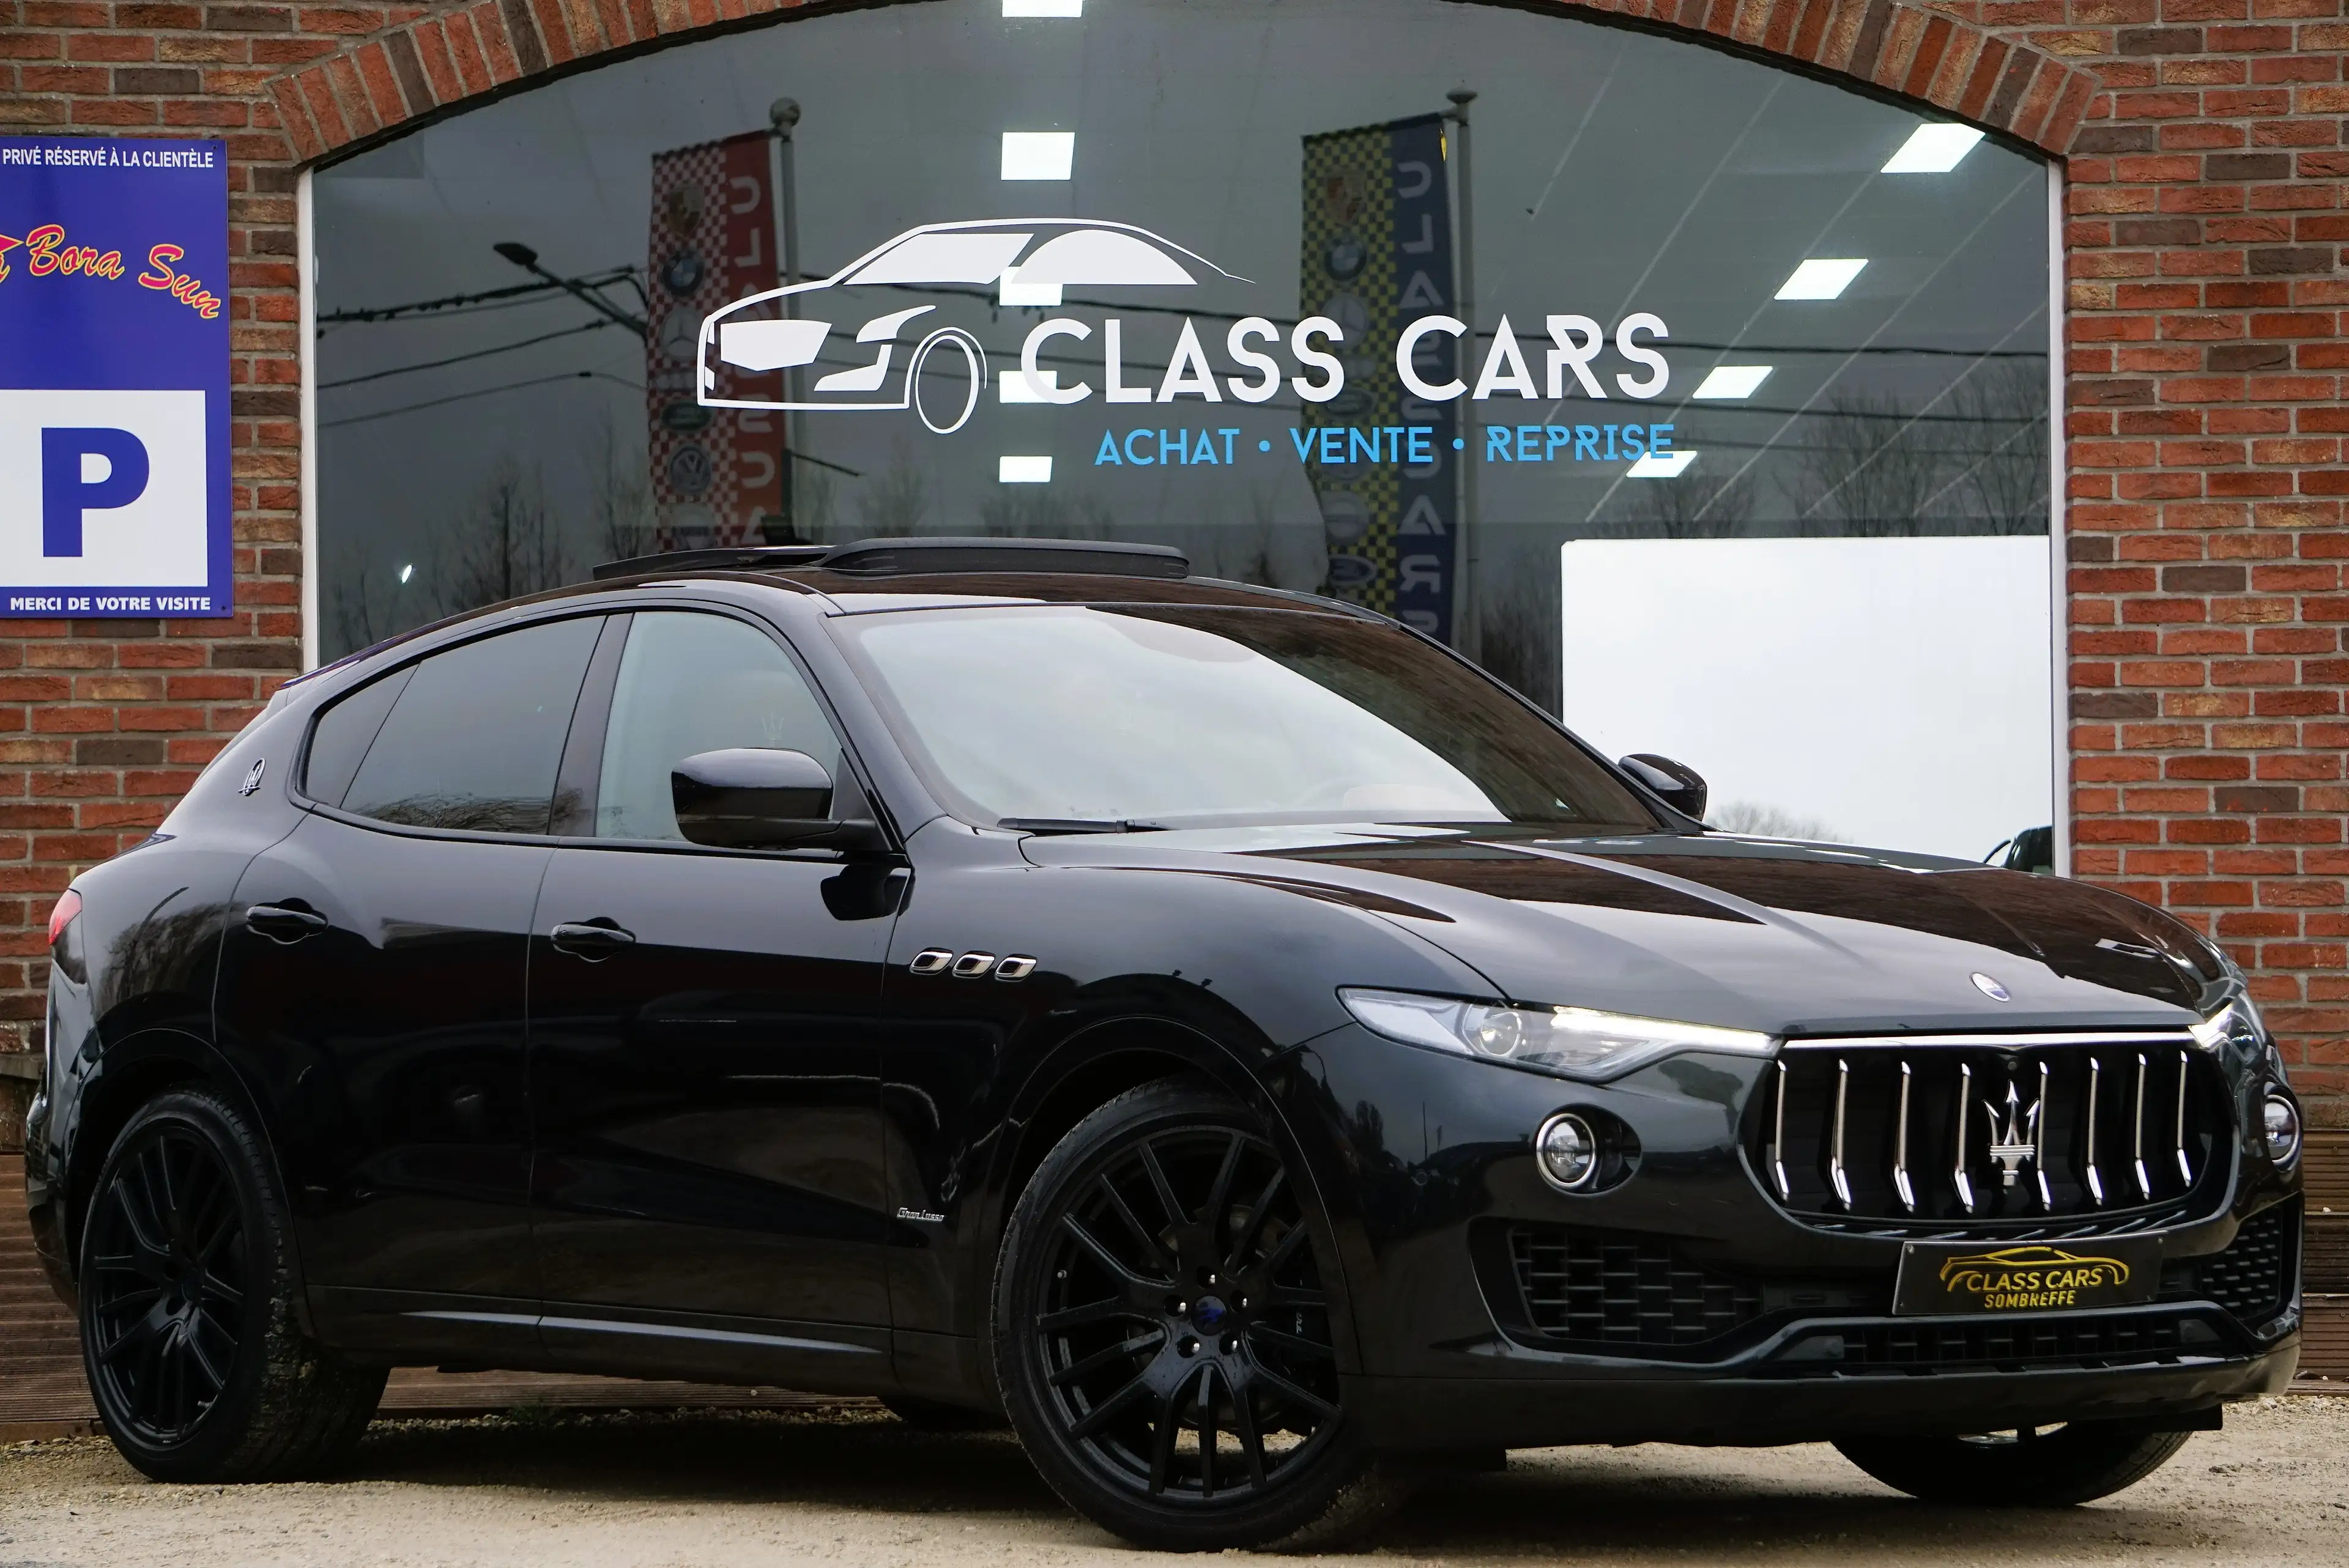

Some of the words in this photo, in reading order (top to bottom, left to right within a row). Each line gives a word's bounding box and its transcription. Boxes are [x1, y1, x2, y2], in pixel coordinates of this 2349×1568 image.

[2, 146, 42, 165] PRIVÉ
[45, 146, 106, 166] RÉSERVÉ
[109, 147, 120, 167] À
[123, 151, 140, 167] LA
[143, 148, 213, 168] CLIENTÈLE
[26, 224, 125, 280] Bora
[138, 243, 221, 319] Sun
[1021, 316, 1345, 405] CLASS
[1396, 312, 1669, 401] CARS
[1094, 428, 1240, 465] ACHAT
[1289, 426, 1433, 464] VENTE
[1486, 424, 1675, 462] REPRISE
[42, 427, 149, 557] P
[10, 597, 62, 611] MERCI
[68, 597, 90, 610] DE
[96, 597, 151, 611] VOTRE
[157, 597, 211, 610] VISITE
[1966, 1271, 2041, 1292] CLASS
[2045, 1268, 2103, 1289] CARS
